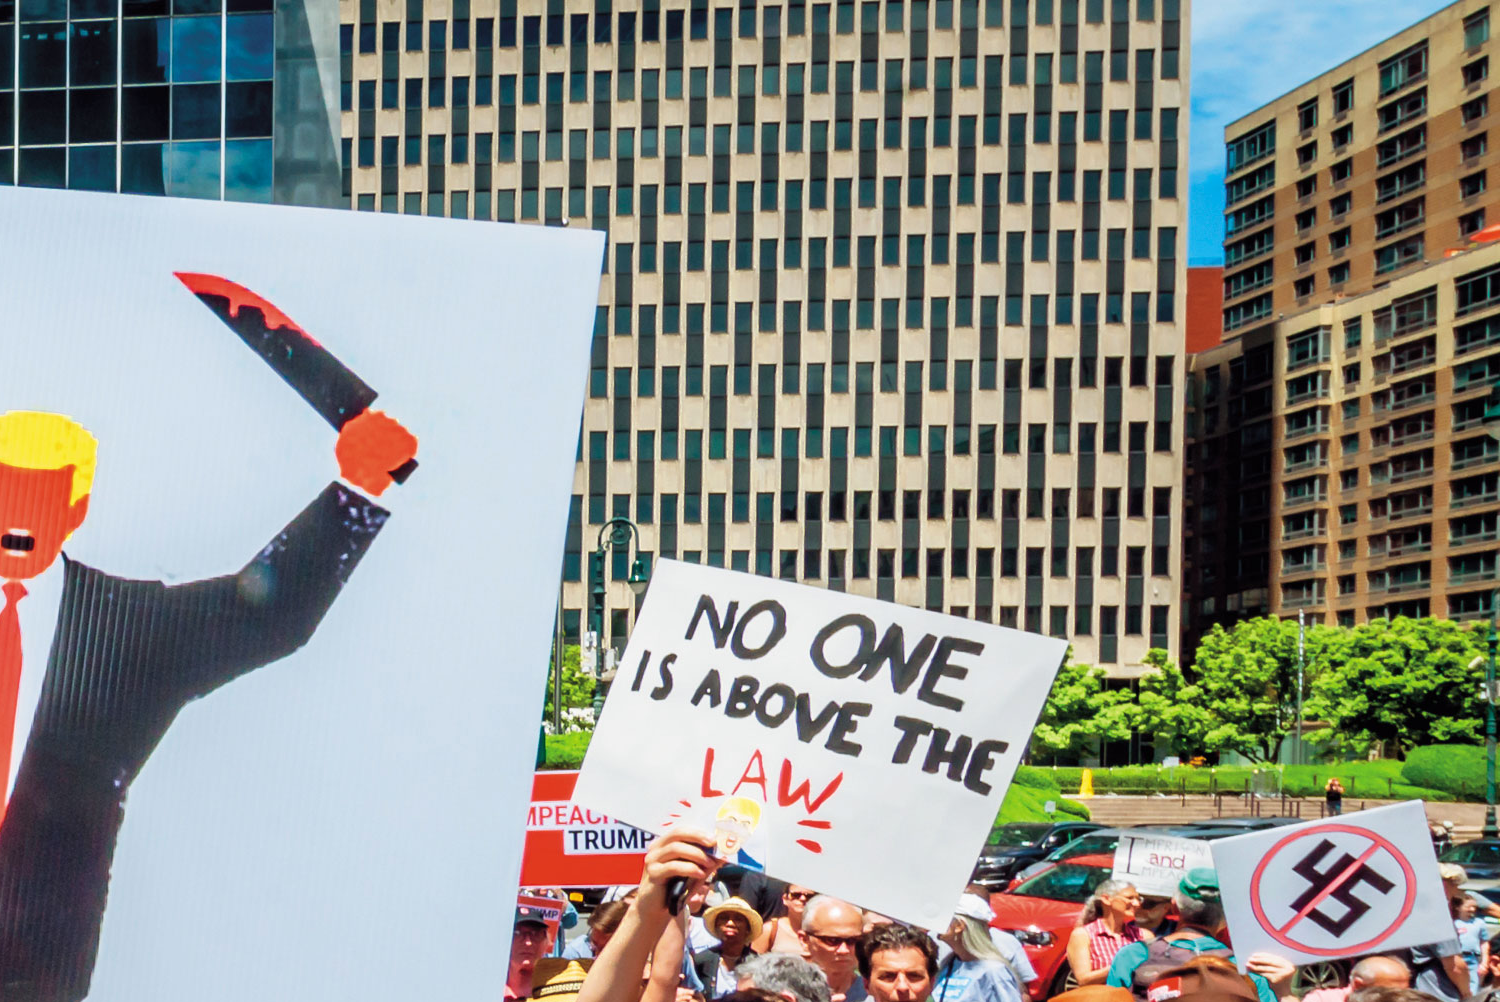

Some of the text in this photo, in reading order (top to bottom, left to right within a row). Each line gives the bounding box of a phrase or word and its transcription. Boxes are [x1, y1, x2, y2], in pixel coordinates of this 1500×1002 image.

[685, 594, 984, 712] NO ONE
[631, 650, 1009, 796] IS ABOVE THE
[701, 747, 843, 814] LAW
[568, 829, 655, 850] TRUMP
[1149, 853, 1185, 869] and
